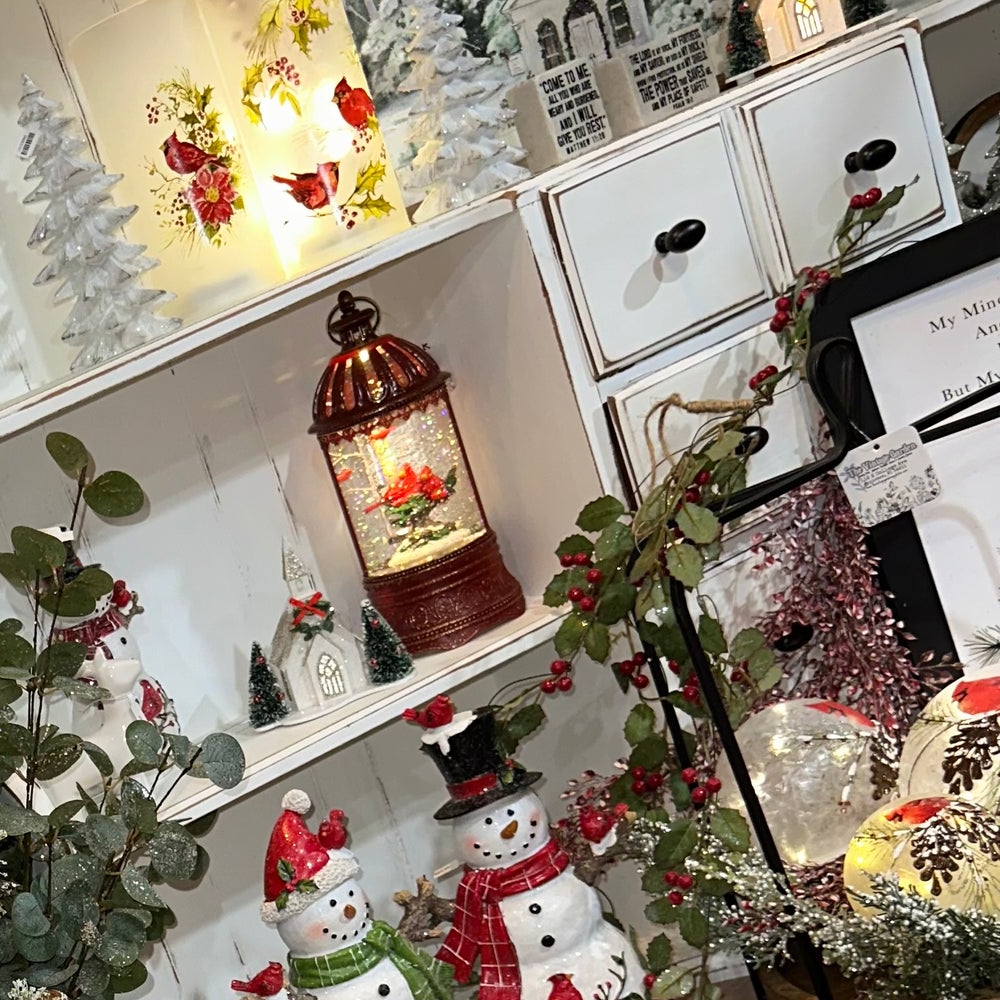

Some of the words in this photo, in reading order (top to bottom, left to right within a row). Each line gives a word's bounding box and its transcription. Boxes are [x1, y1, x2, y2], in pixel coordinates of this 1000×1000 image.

[564, 69, 576, 85] TO
[639, 85, 655, 104] THE
[654, 75, 680, 97] POWER
[686, 64, 706, 83] SAVES
[548, 93, 559, 105] ALL
[558, 89, 570, 101] YOU
[569, 84, 581, 96] WHO
[581, 79, 592, 91] ARE
[659, 95, 667, 108] MY
[666, 88, 683, 104] PLACE
[683, 86, 690, 97] OF
[559, 116, 573, 131] AND
[577, 104, 597, 122] WILL
[557, 131, 573, 148] GIVE
[572, 125, 586, 140] YOU
[928, 315, 956, 334] My
[975, 321, 1000, 340] An
[941, 383, 970, 402] But
